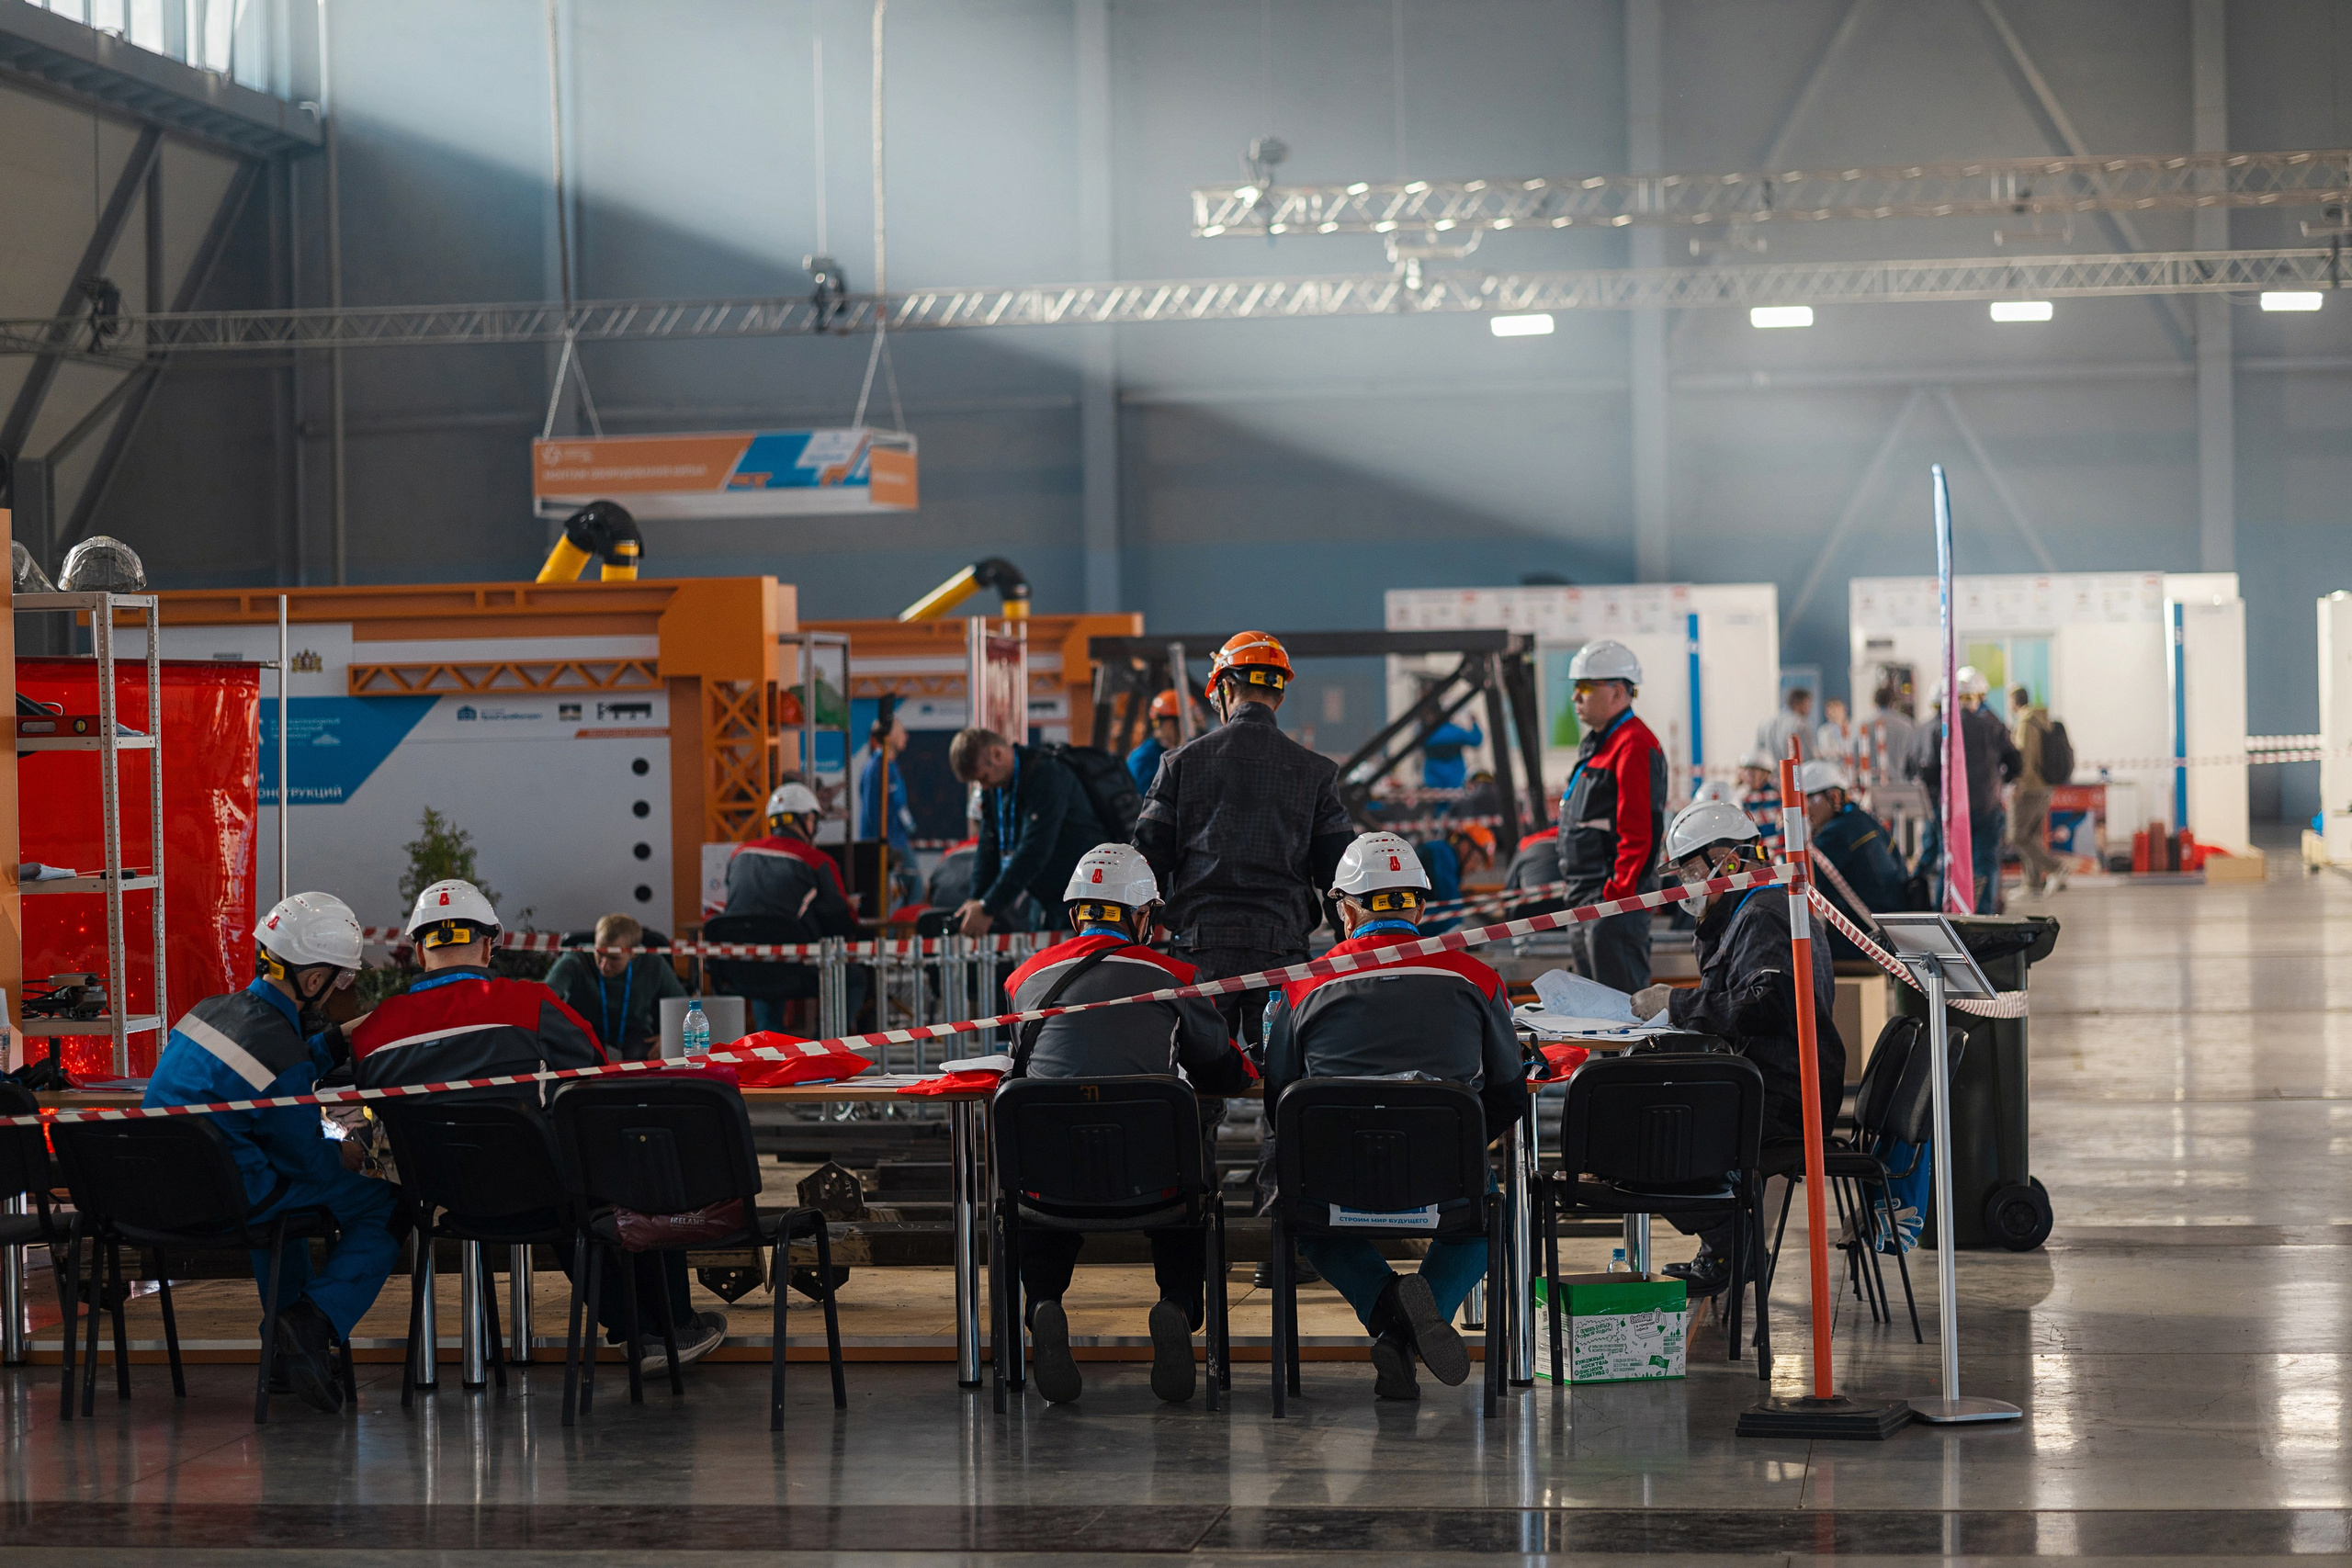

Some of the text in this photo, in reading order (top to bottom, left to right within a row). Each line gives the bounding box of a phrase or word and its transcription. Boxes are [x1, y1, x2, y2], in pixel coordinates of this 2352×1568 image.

[258, 784, 342, 799] ОНСТРУКЦИЙ
[670, 1217, 706, 1225] IRELAND
[1580, 1359, 1609, 1369] НОСИТЕЛЬ
